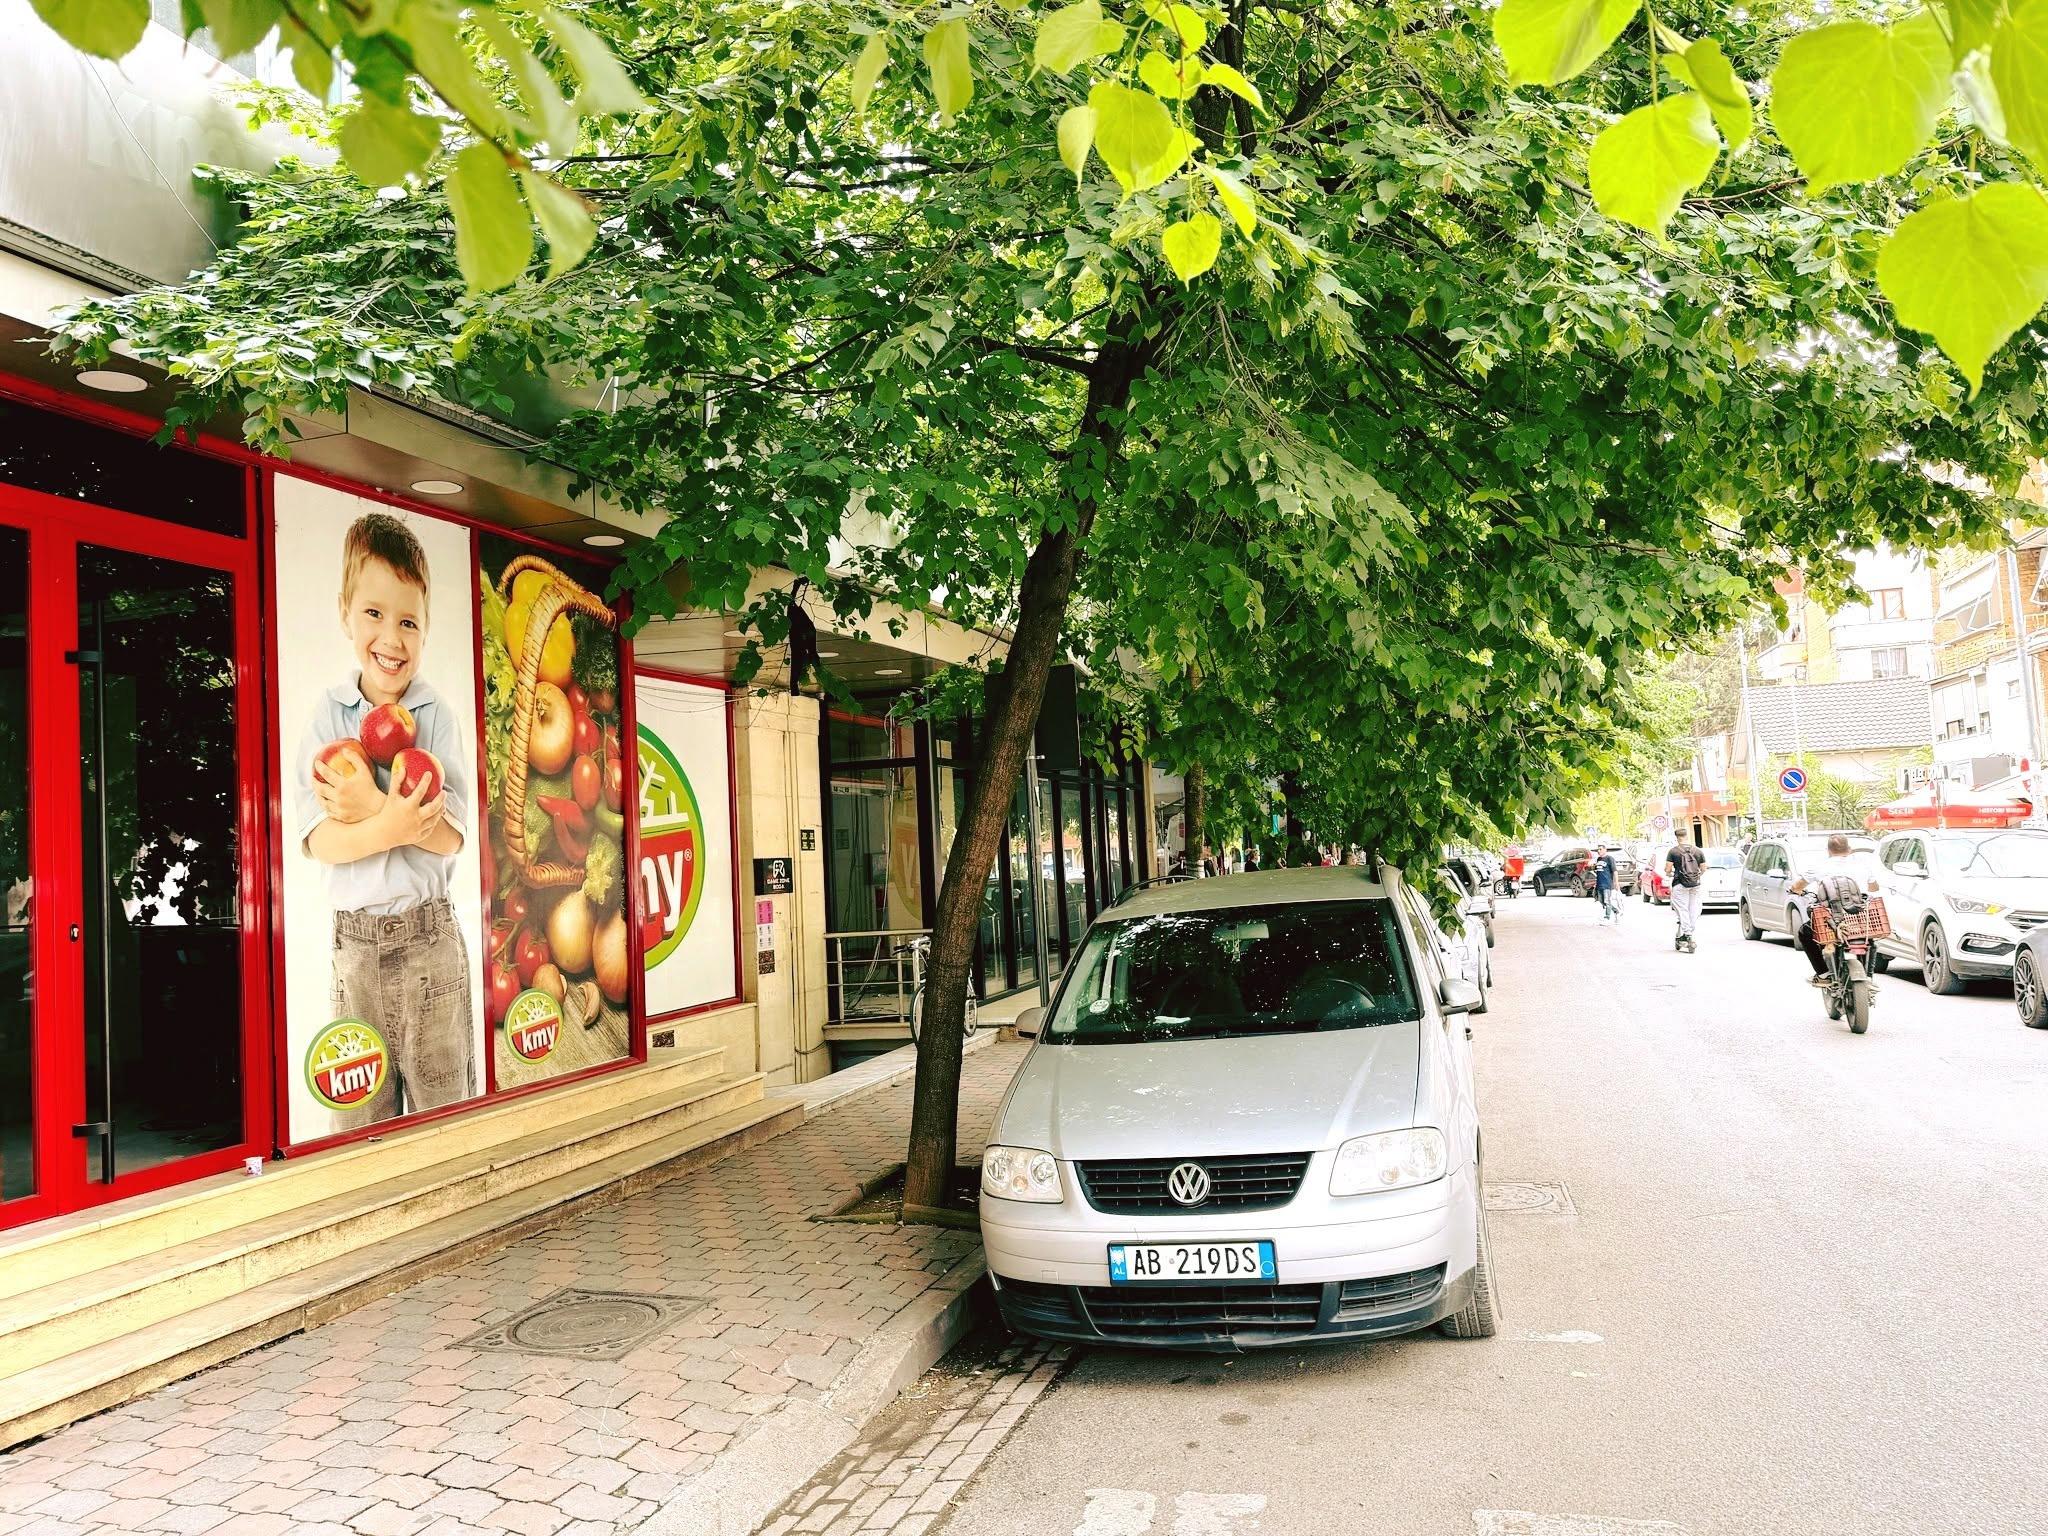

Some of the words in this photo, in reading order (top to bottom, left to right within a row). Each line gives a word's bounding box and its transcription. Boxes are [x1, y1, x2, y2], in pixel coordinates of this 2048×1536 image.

[521, 1024, 556, 1054] kmy
[329, 1060, 378, 1098] kmy
[1134, 1249, 1161, 1275] AB
[1176, 1246, 1257, 1275] 219DS
